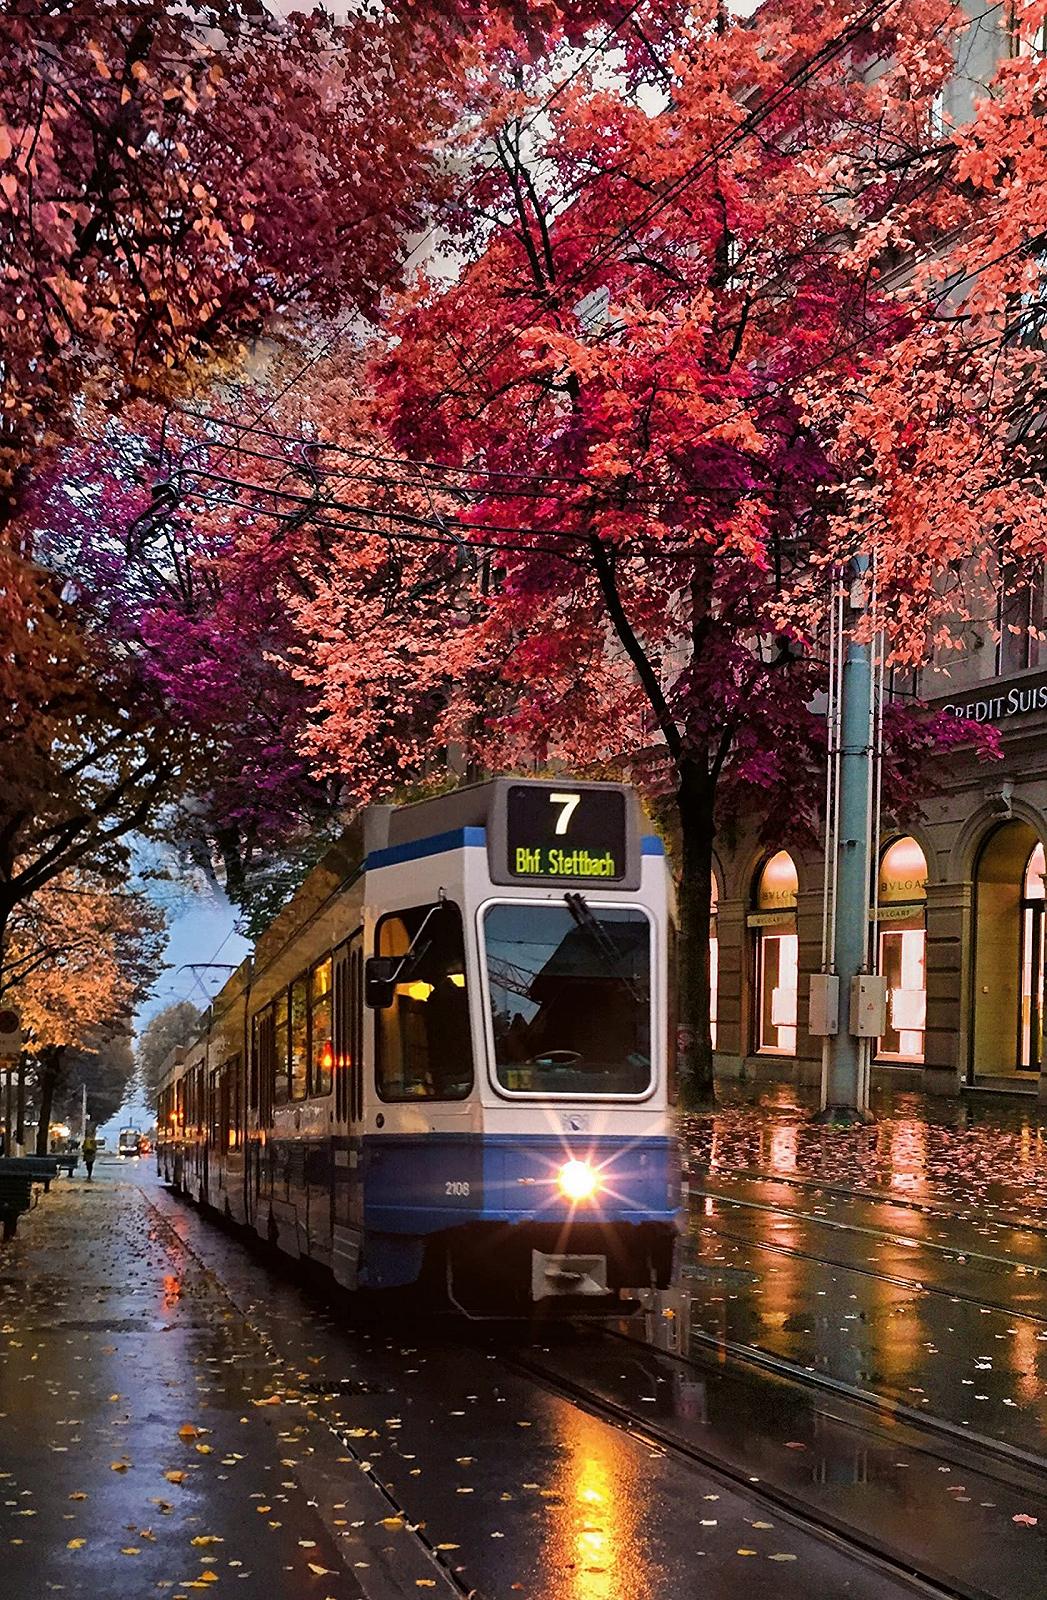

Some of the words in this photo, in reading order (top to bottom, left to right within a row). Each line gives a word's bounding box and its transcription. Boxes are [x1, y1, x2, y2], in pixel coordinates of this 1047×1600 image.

[549, 793, 581, 835] 7
[515, 847, 544, 874] Bhf.
[548, 849, 616, 877] Stettbach
[445, 1180, 470, 1197] 2108
